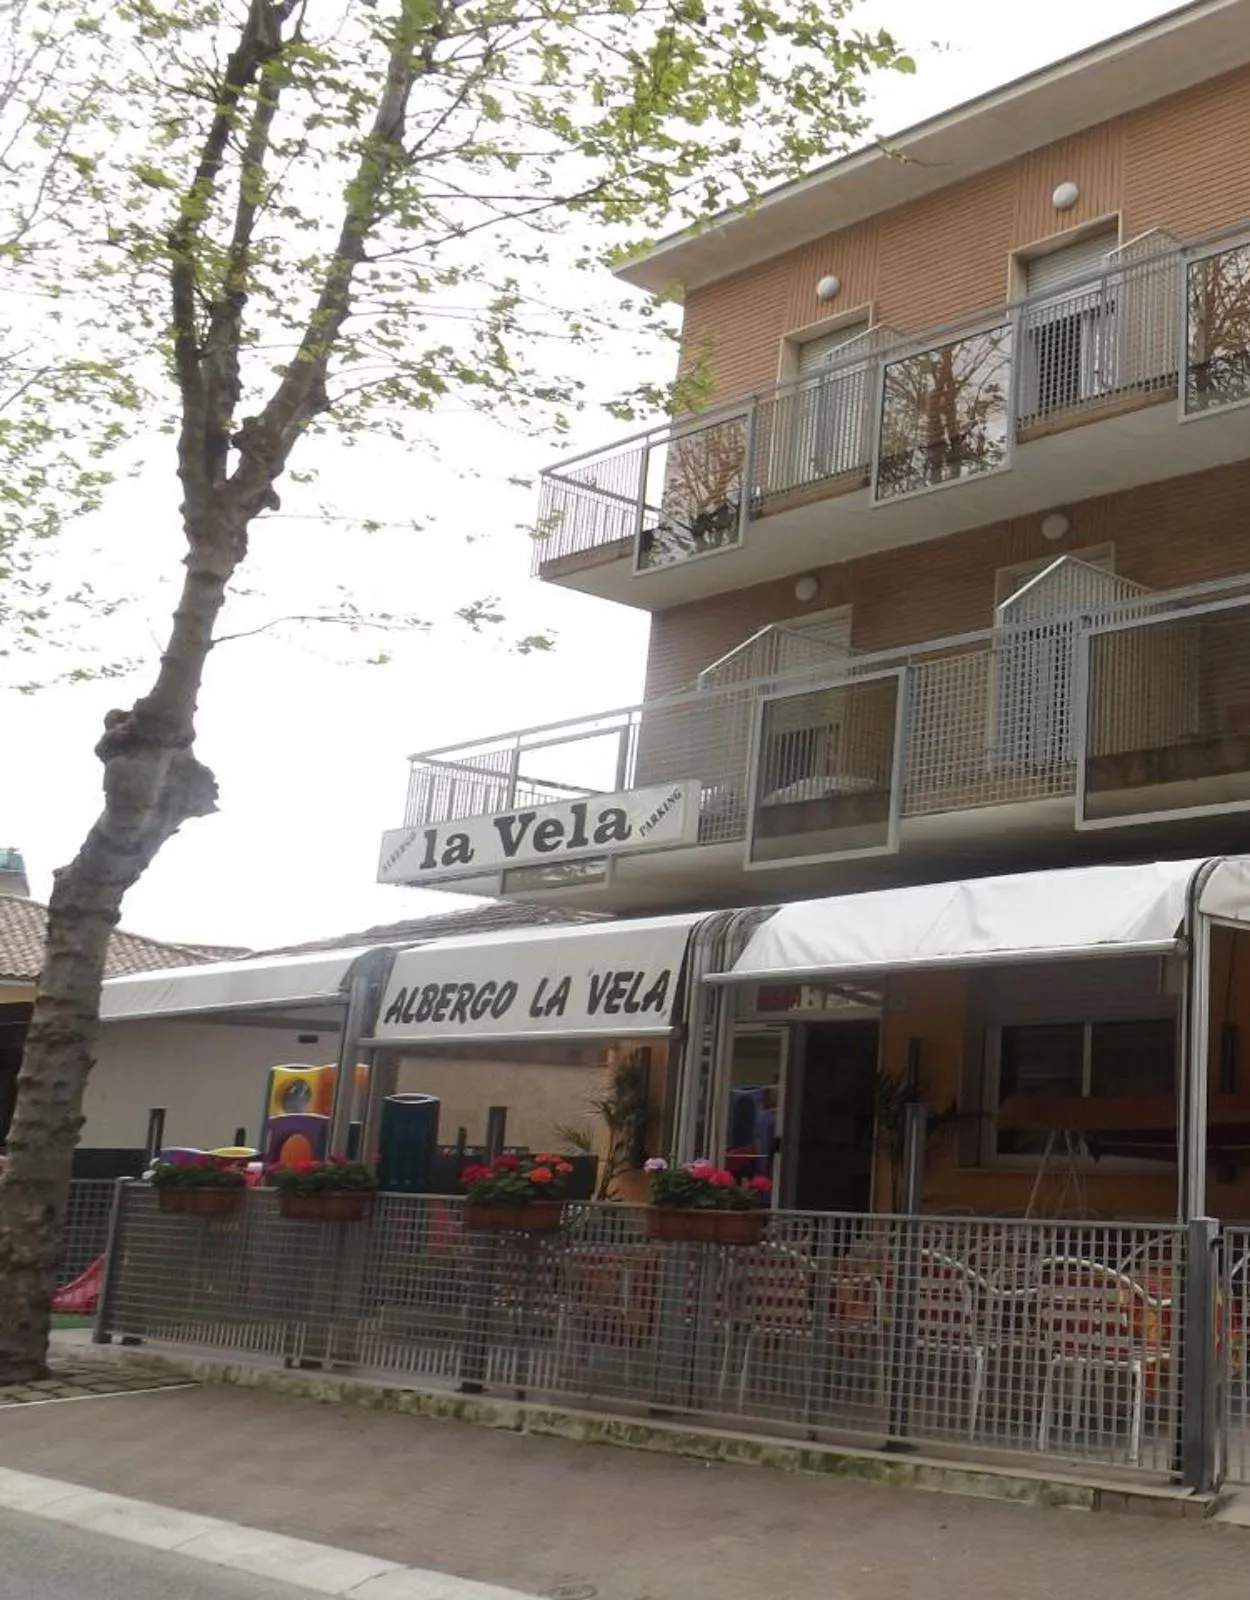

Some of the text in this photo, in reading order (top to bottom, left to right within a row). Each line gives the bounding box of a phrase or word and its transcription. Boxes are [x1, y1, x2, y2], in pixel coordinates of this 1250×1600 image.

[420, 802, 633, 869] la Vela
[638, 788, 682, 837] PARKING
[383, 980, 519, 1024] ALBERGO
[529, 976, 572, 1018] LA
